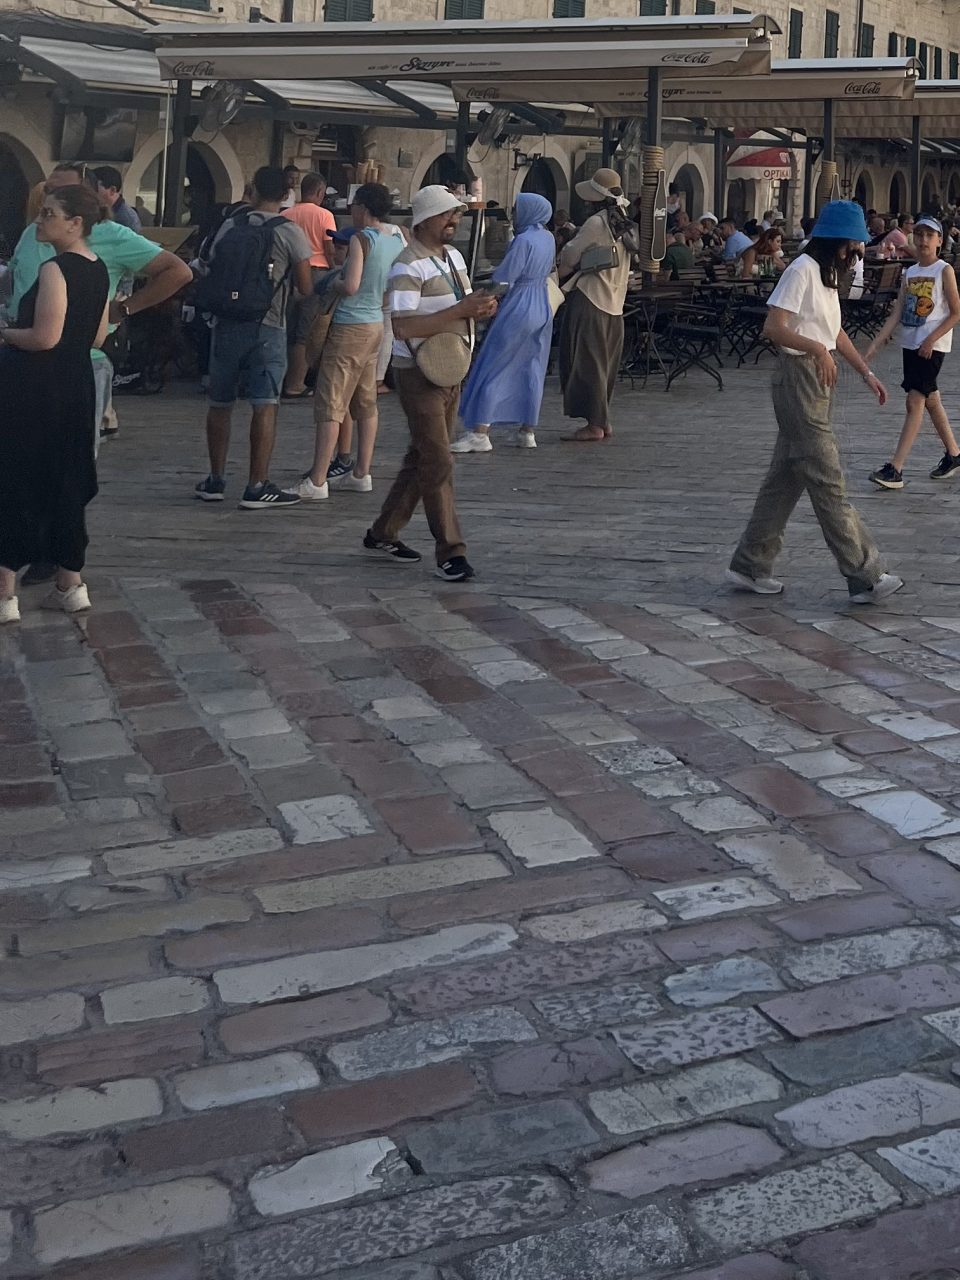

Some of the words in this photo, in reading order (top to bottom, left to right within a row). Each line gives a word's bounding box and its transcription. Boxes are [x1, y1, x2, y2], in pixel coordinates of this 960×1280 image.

[399, 56, 455, 71] Siempre
[661, 51, 713, 64] Coca-Cola
[844, 81, 881, 94] Coca-Cola
